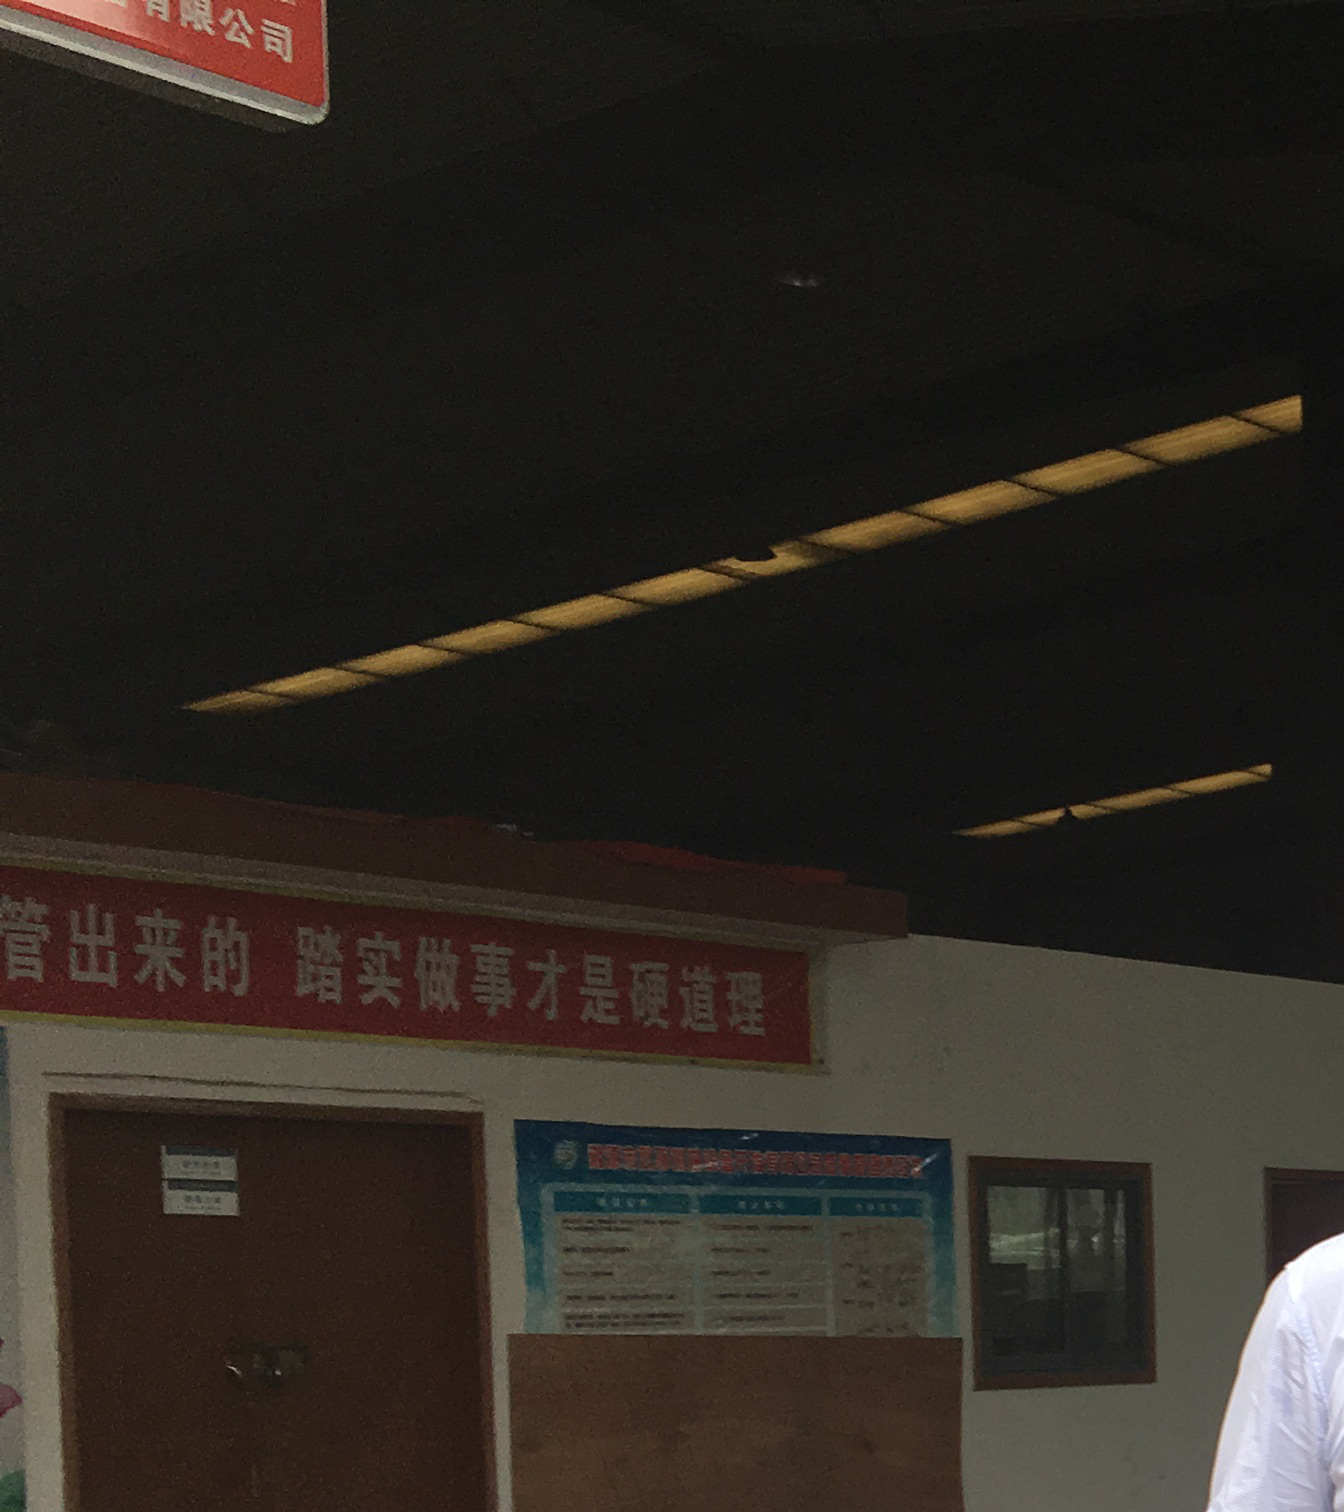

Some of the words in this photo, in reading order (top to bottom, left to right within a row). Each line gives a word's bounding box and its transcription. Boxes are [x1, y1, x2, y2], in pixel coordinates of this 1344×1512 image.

[104, 0, 293, 63] 有限公司
[0, 896, 252, 997] 管出来的
[294, 925, 769, 1038] 踏实做事才是硬道理
